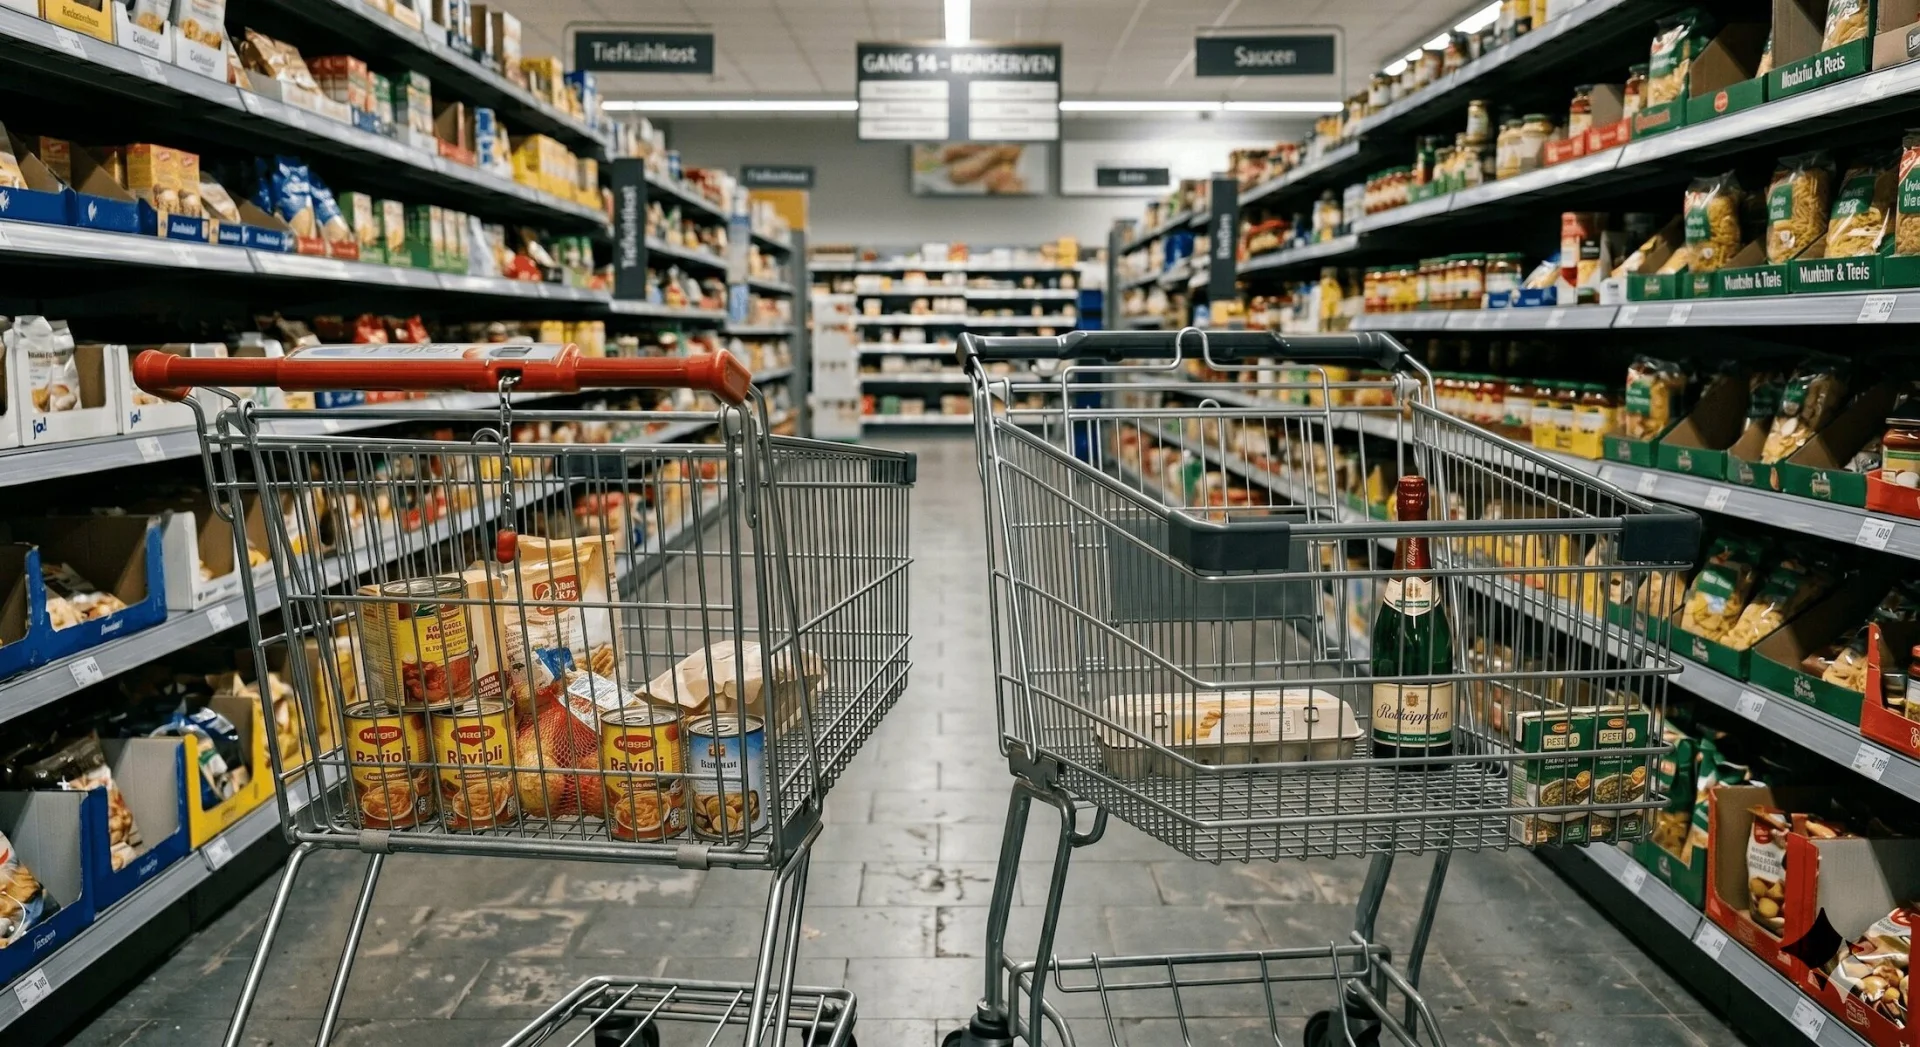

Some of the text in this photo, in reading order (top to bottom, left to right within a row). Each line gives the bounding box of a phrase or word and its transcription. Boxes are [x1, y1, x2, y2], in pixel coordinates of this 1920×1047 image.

[591, 41, 697, 63] Tiefkühlkost
[1234, 45, 1297, 67] Saucen
[862, 53, 913, 73] GANG
[916, 53, 938, 73] 14
[951, 53, 1056, 73] KONSERVEN
[1836, 263, 1845, 281] &
[33, 417, 47, 439] ja!
[130, 409, 142, 429] ja!
[447, 744, 503, 764] Ravioli
